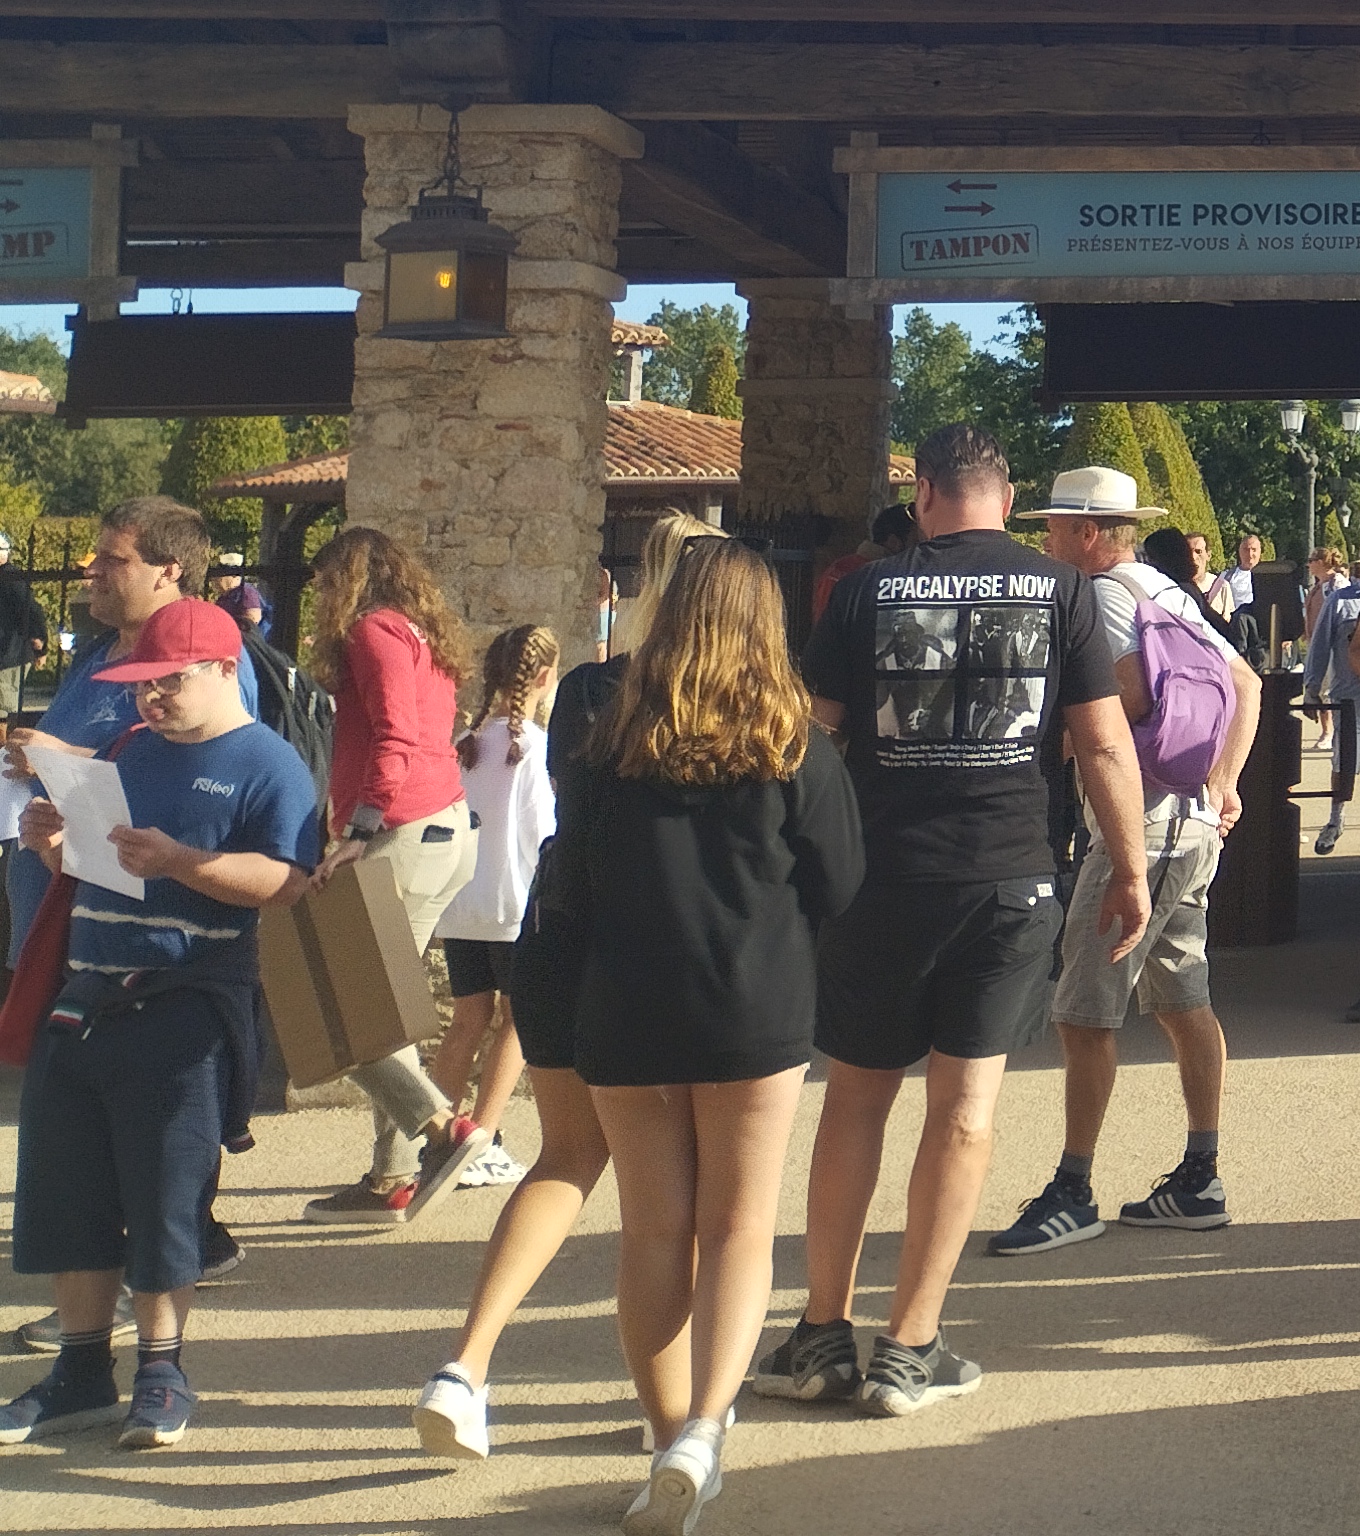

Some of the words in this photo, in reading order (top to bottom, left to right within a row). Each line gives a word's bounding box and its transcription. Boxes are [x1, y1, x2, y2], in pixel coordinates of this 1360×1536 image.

[1079, 203, 1181, 228] SORTIE
[909, 232, 1032, 261] TAMPON
[1066, 234, 1230, 253] PRÉSENTEZ-VOUS
[1237, 233, 1250, 251] À
[1257, 236, 1295, 251] NOS
[876, 574, 1004, 600] 2PACALYPSE
[1008, 573, 1057, 600] NOW
